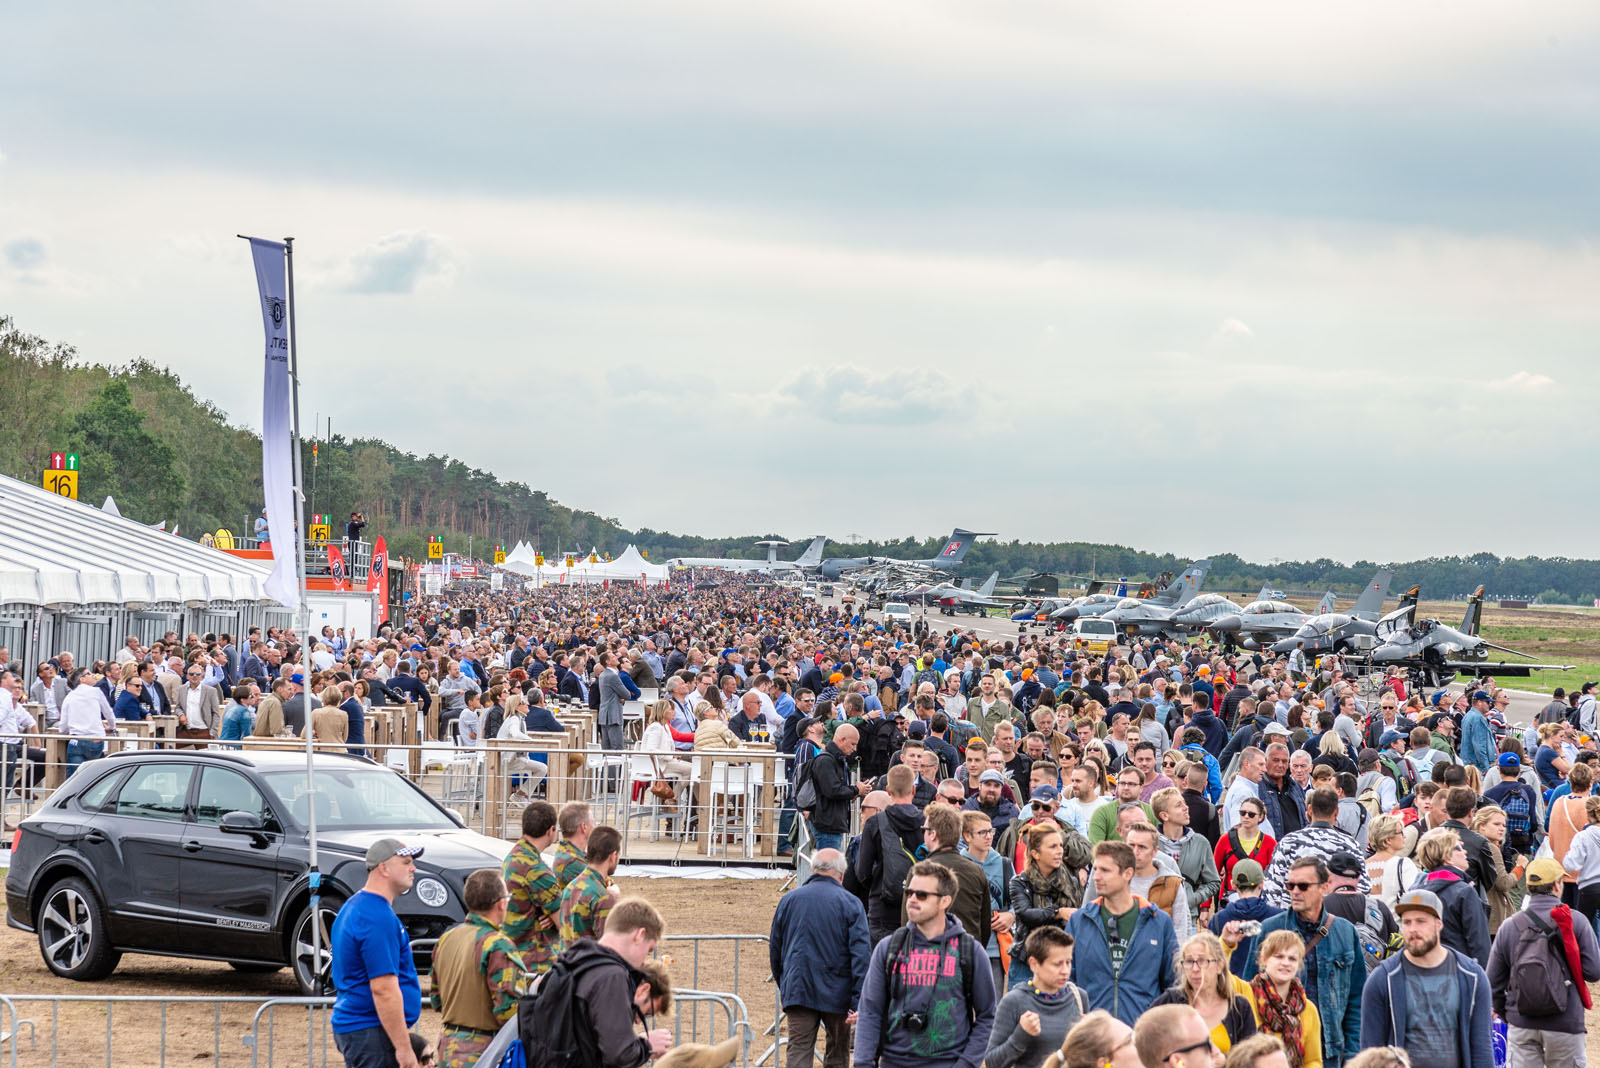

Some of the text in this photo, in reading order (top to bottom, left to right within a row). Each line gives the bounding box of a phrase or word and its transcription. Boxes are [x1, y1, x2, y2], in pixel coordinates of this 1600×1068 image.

[50, 475, 71, 497] 16
[312, 527, 326, 542] 15
[431, 545, 441, 556] 14
[497, 553, 504, 562] 13
[216, 918, 239, 927] BENTLEY
